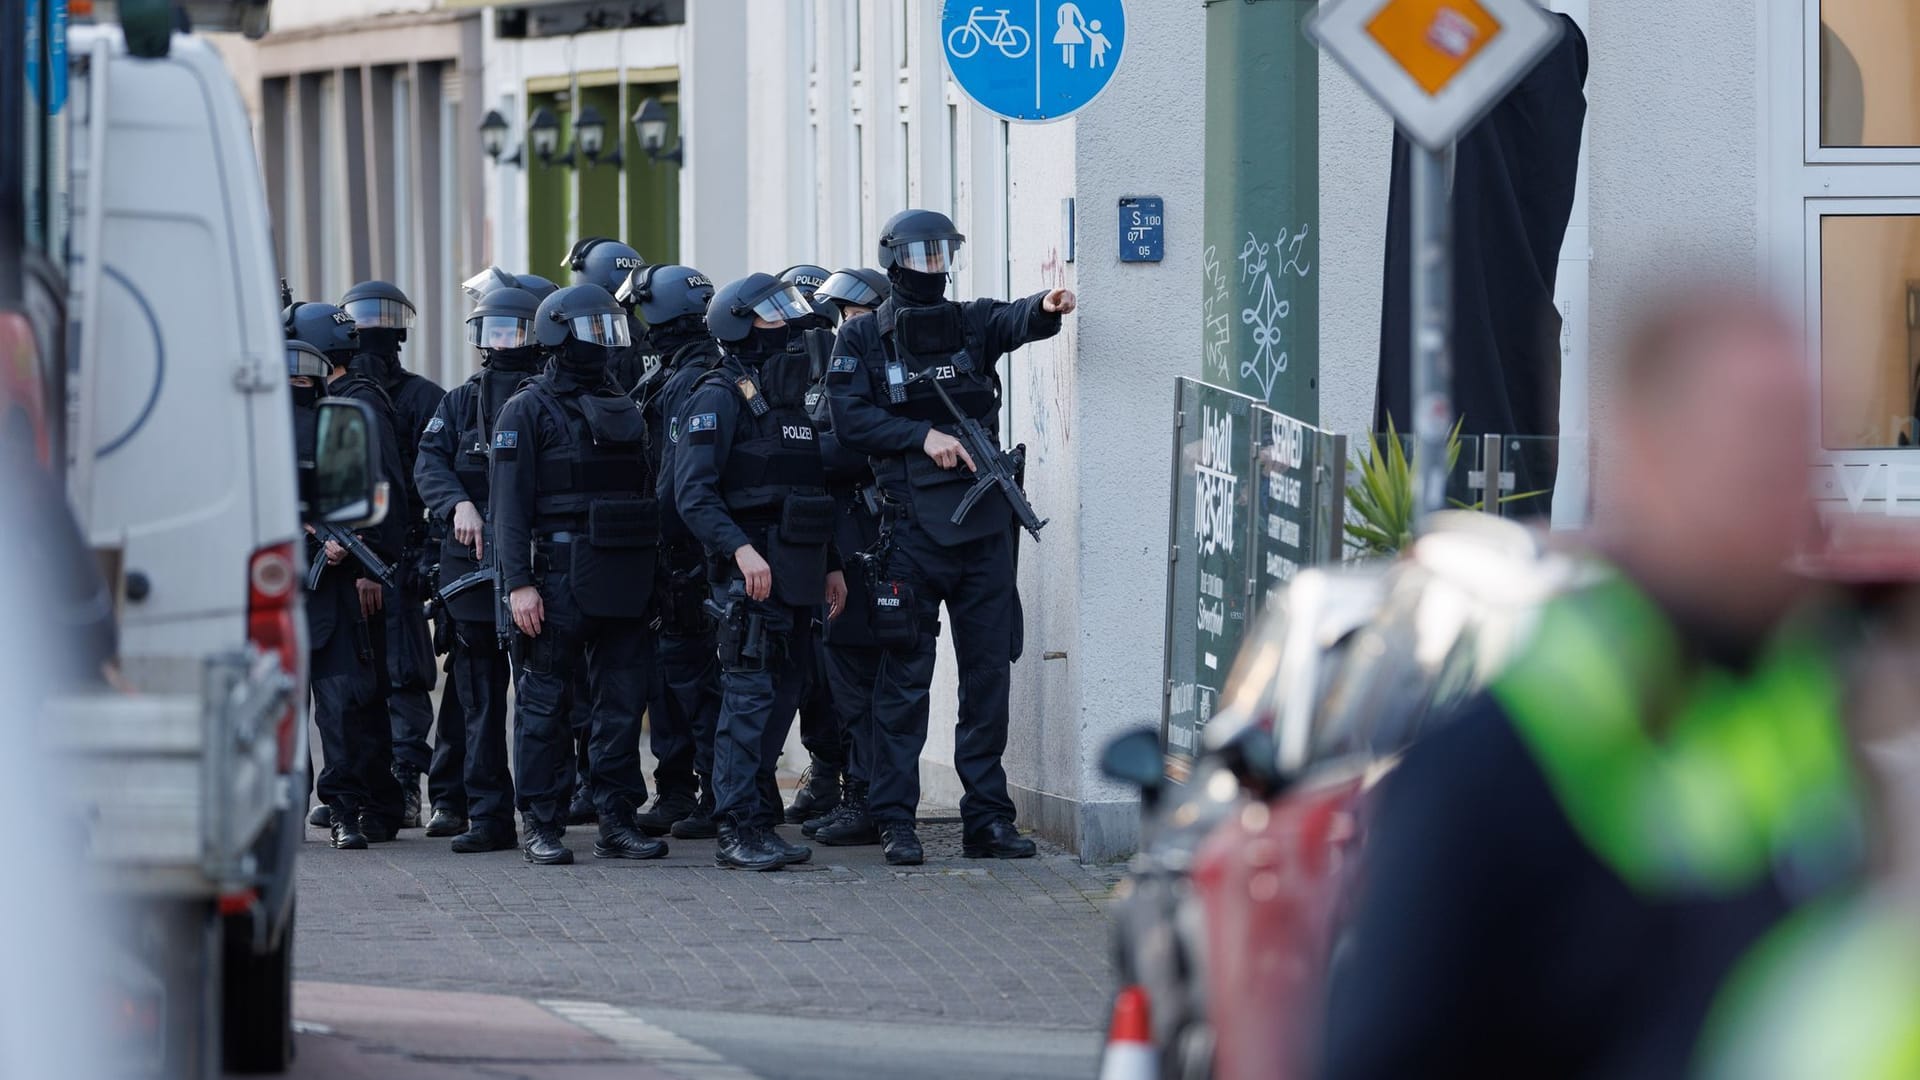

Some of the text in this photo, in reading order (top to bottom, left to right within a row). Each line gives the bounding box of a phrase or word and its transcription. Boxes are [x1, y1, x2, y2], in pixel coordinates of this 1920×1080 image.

[1132, 211, 1160, 225] S 100
[615, 257, 643, 269] POLIZE
[795, 275, 826, 287] POLIZE
[782, 425, 813, 440] POLIZEI
[877, 597, 900, 607] POLIZEI
